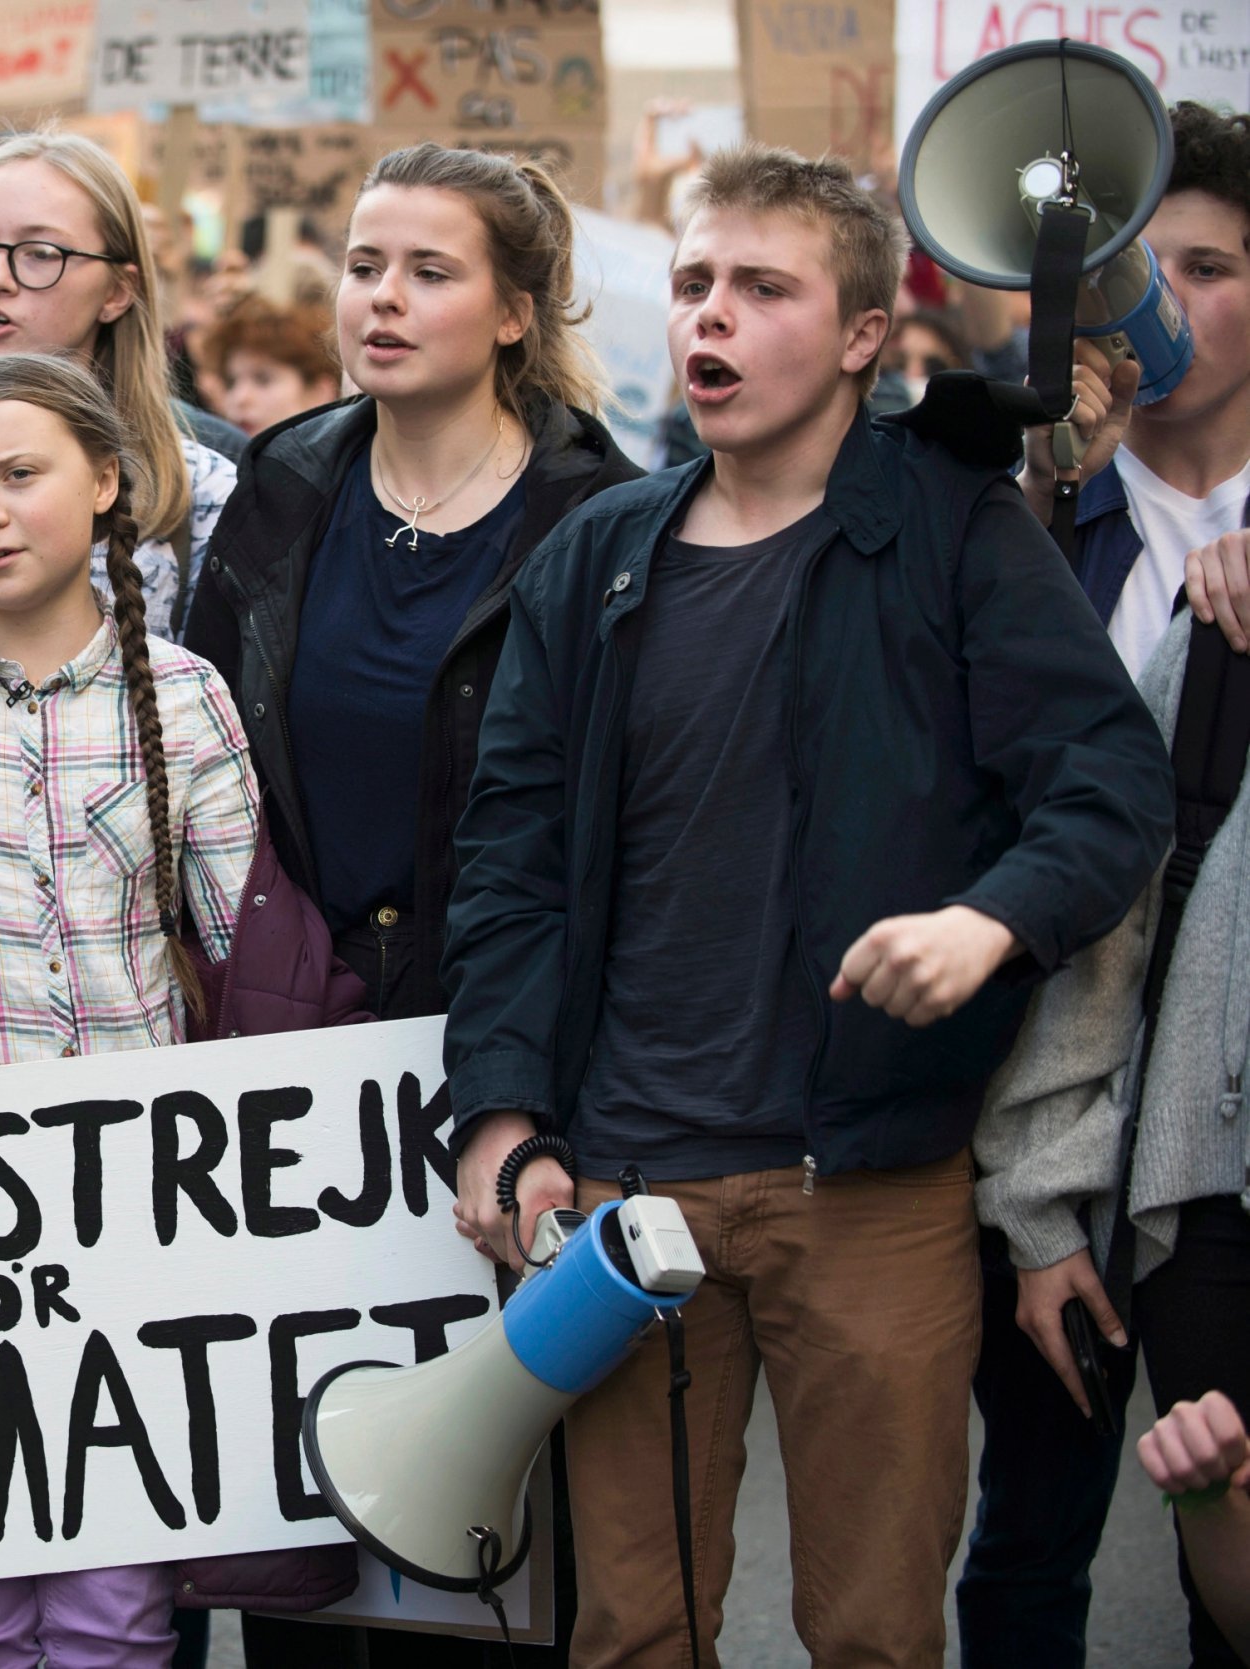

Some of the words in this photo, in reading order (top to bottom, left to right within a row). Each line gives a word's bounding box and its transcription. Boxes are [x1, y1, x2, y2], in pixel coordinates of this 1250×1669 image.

[1180, 11, 1217, 34] DE
[103, 35, 156, 87] DE
[177, 28, 301, 88] TERRE
